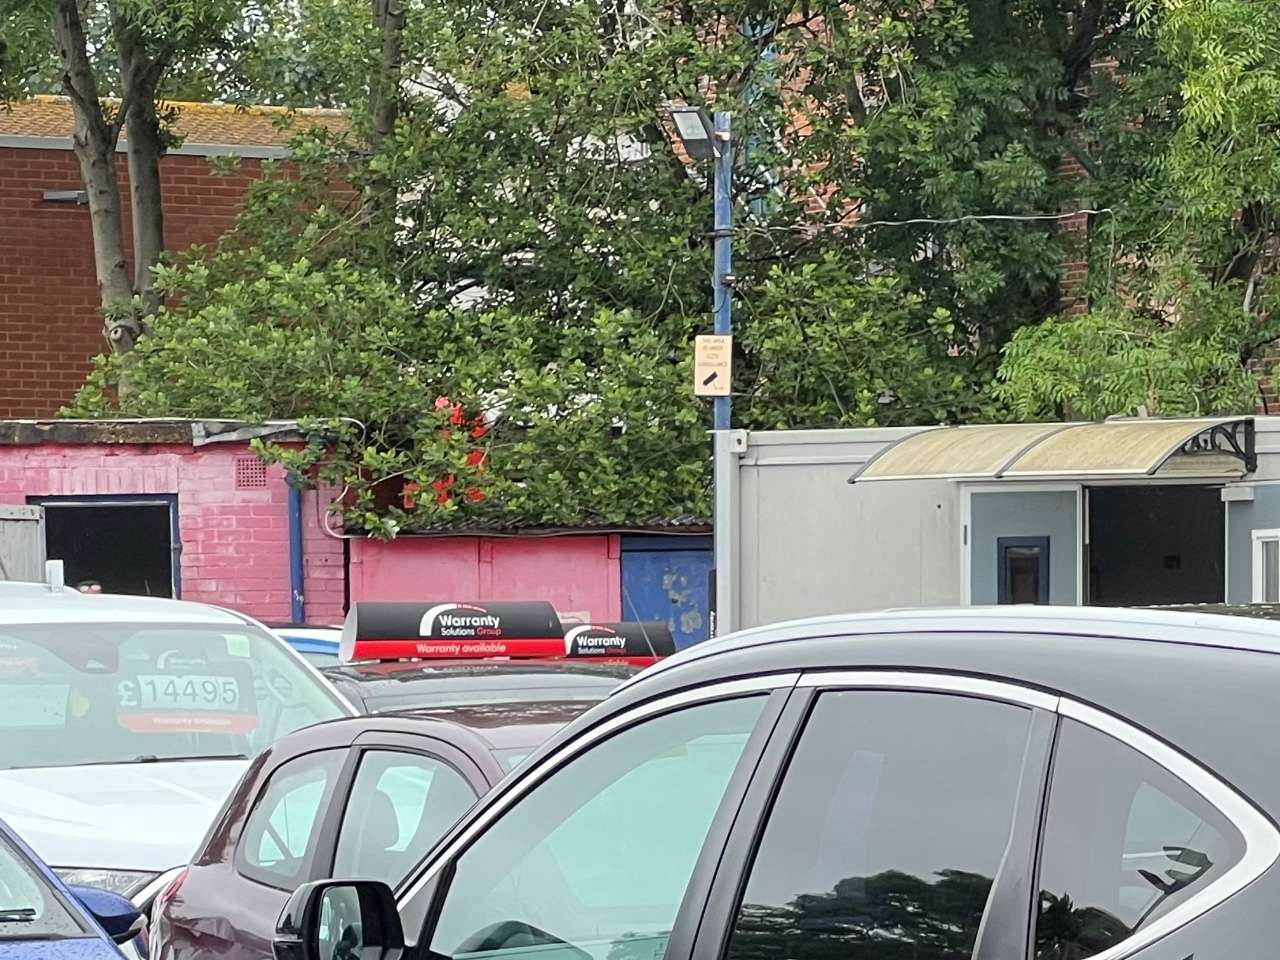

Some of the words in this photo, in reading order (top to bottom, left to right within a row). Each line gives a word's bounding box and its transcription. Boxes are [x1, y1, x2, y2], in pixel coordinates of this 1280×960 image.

[439, 614, 500, 629] Warranty
[441, 627, 475, 636] Solutions
[477, 628, 502, 637] Group
[416, 643, 460, 655] Warranty
[462, 642, 507, 654] available
[576, 636, 626, 648] Warranty
[117, 679, 238, 706] £14495
